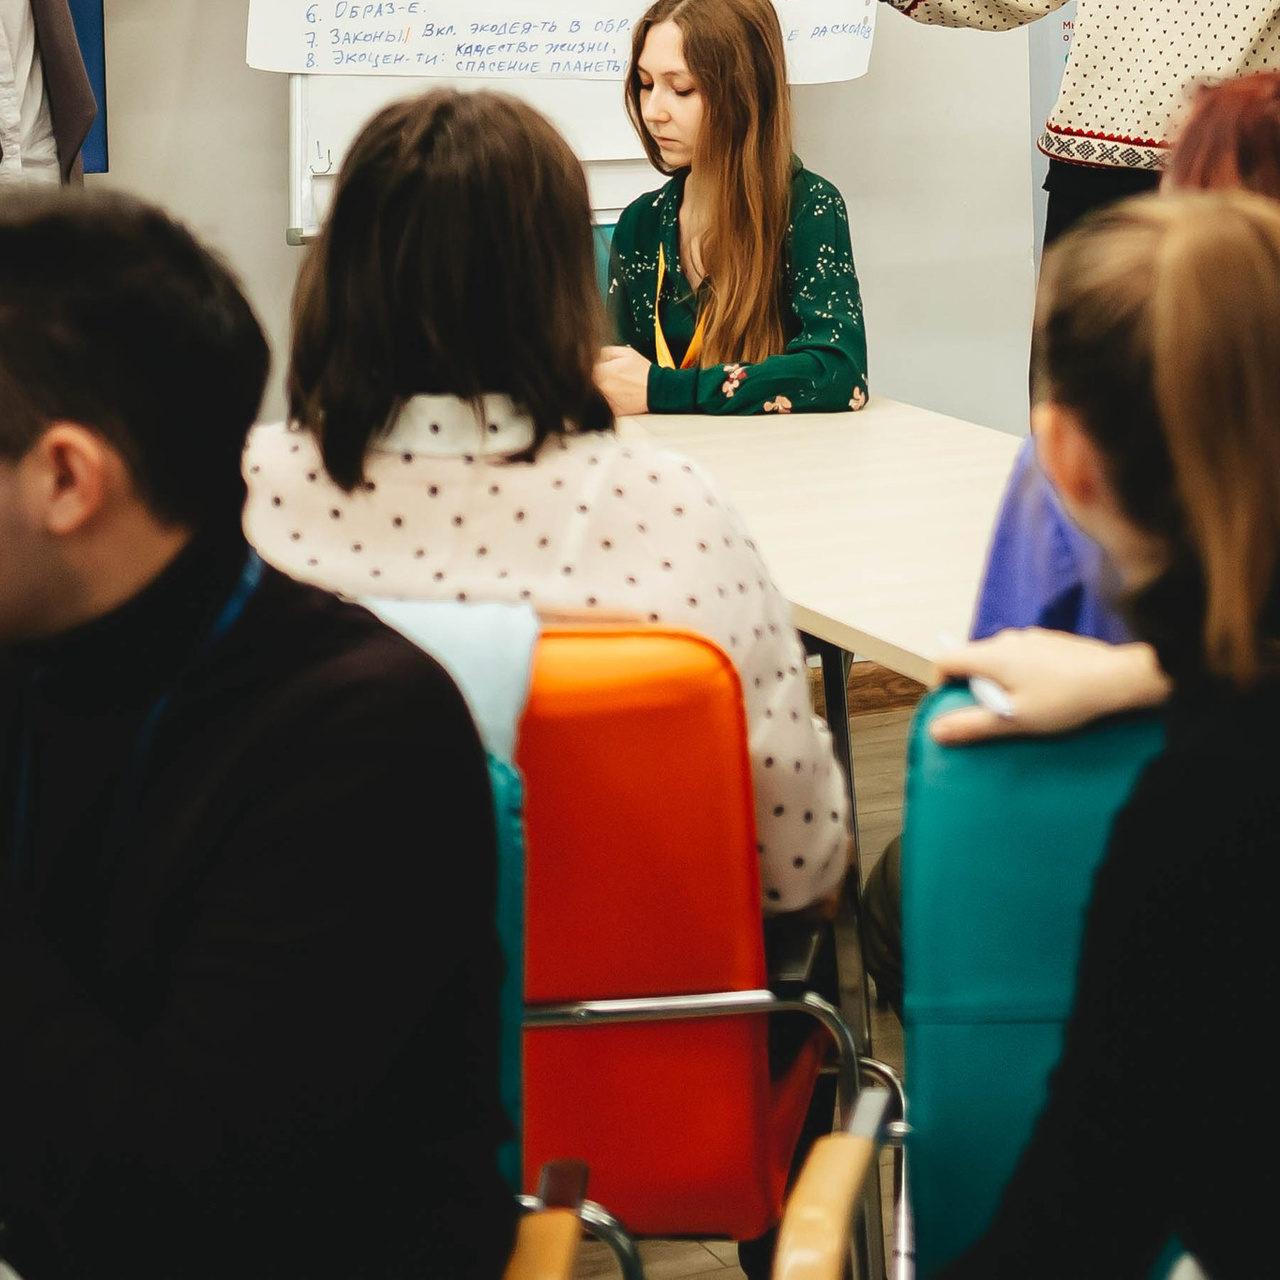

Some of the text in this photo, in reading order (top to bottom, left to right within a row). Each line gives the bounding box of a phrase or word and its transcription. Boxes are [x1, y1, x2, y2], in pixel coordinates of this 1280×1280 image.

[305, 3, 322, 24] 6.
[304, 31, 318, 48] 7.
[568, 20, 581, 33] В
[305, 53, 319, 68] 8.
[455, 60, 541, 73] СПАСЕНИЕ
